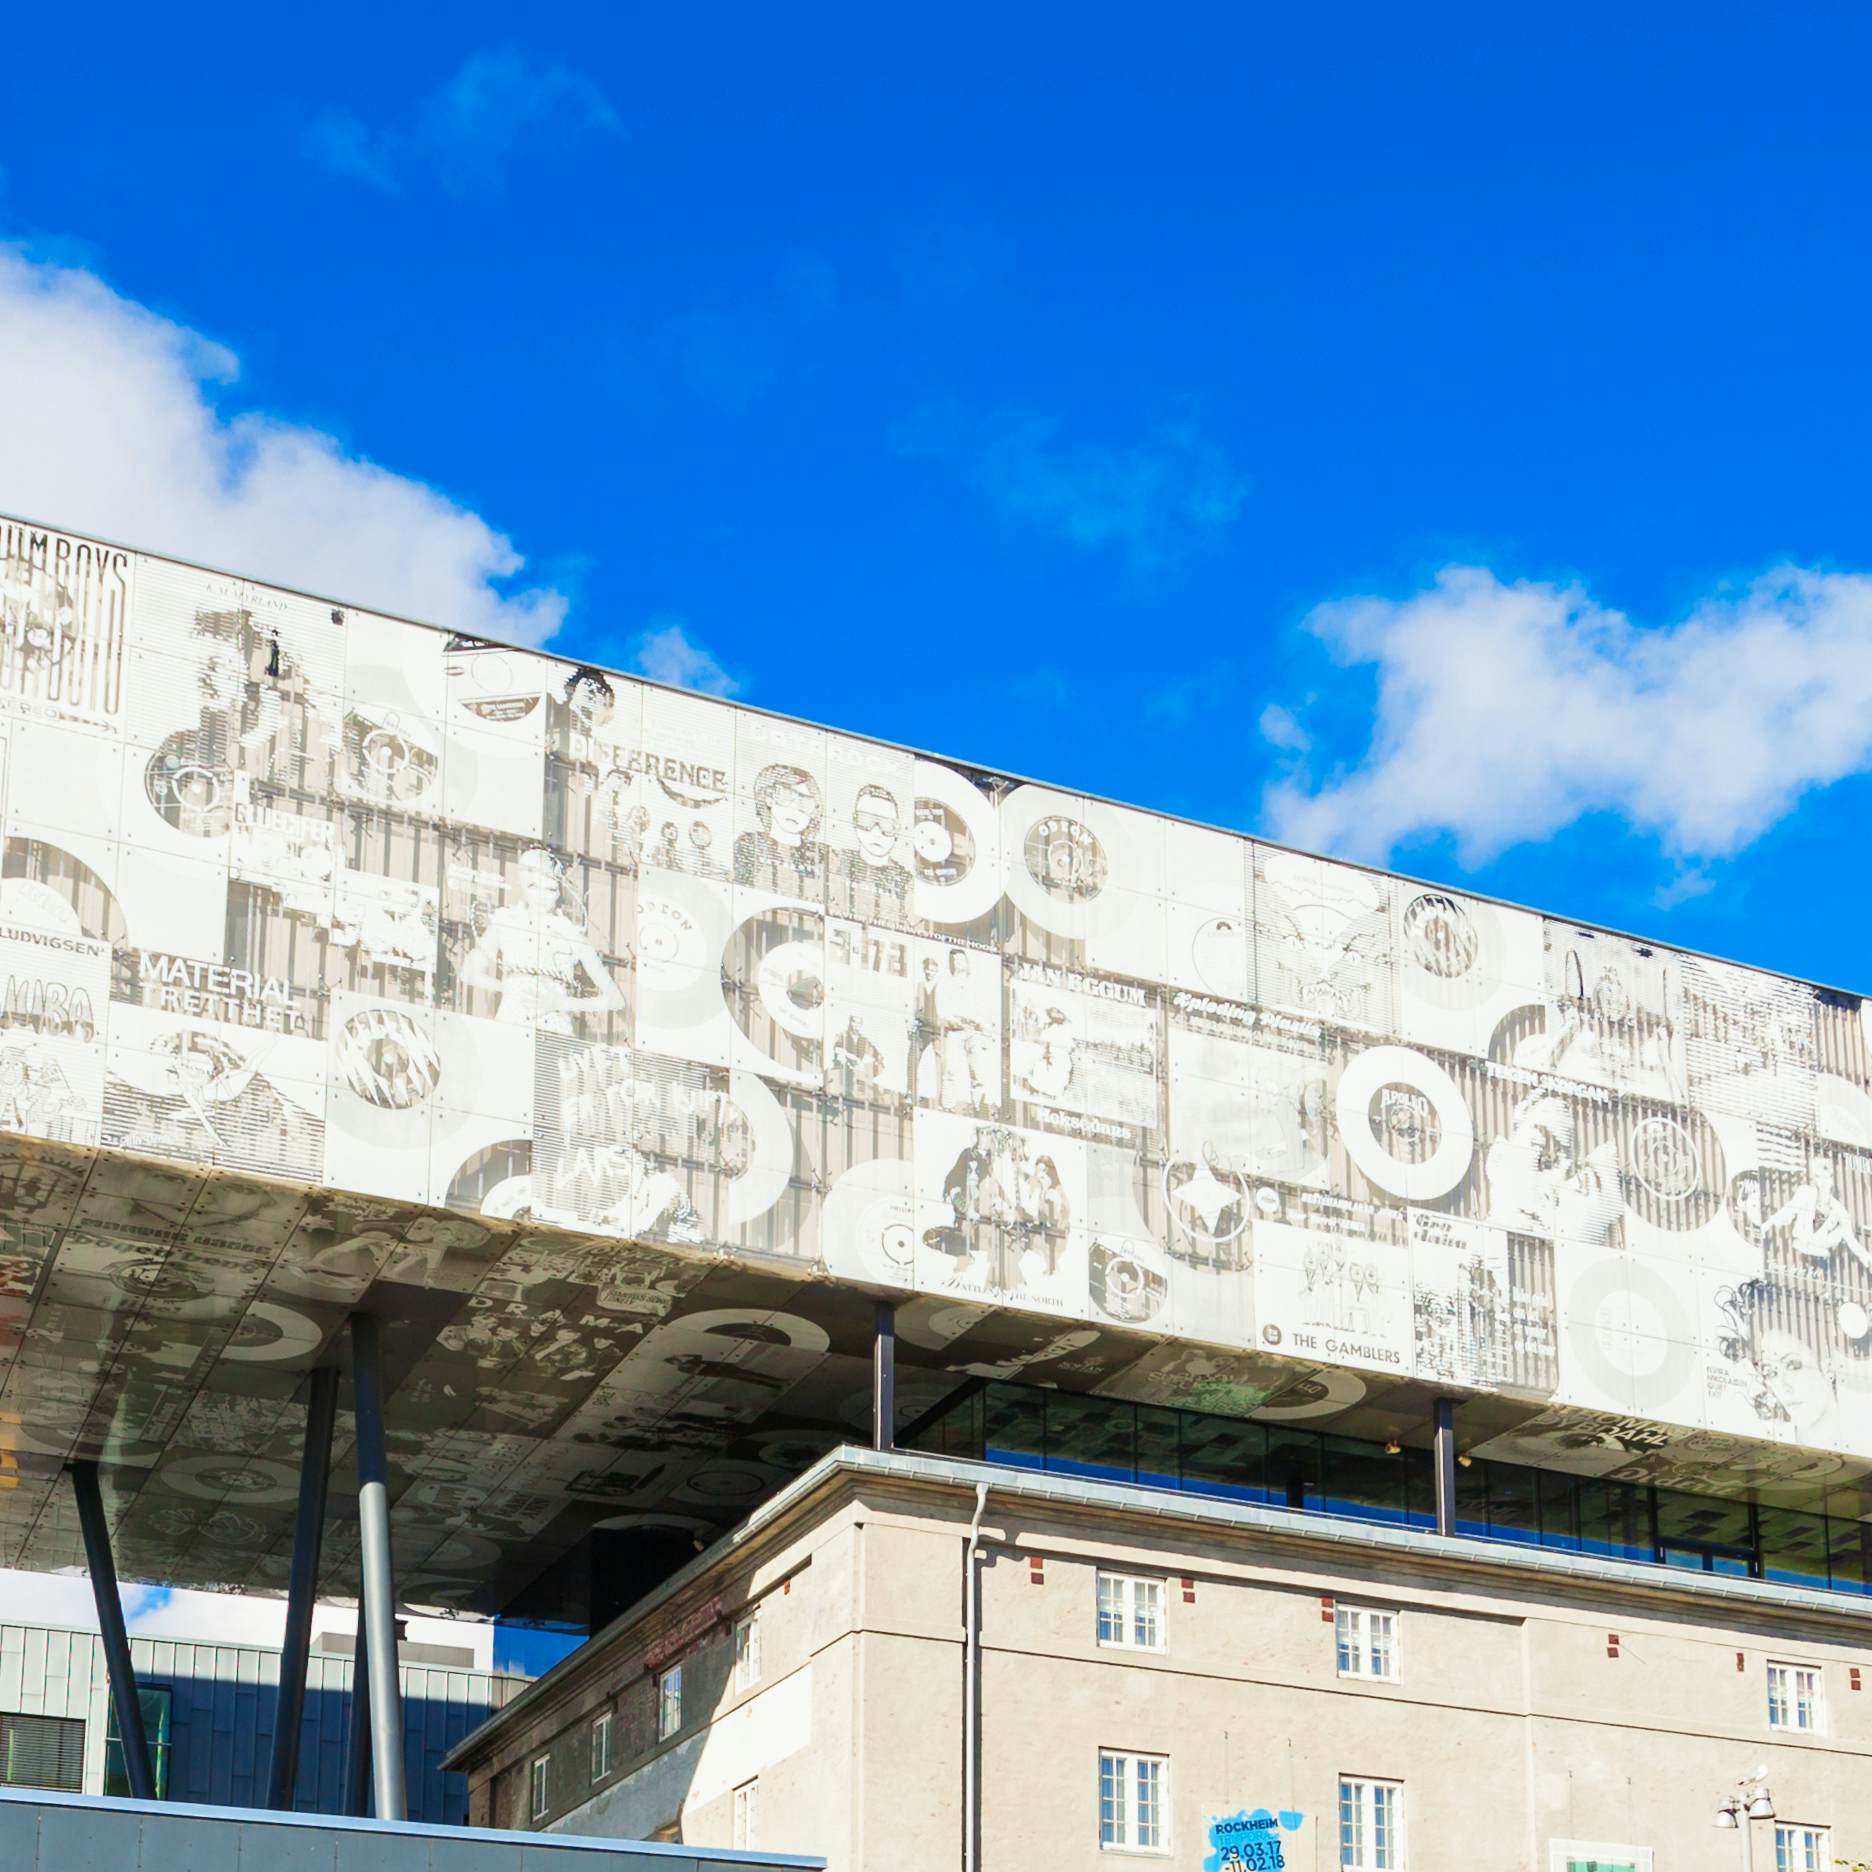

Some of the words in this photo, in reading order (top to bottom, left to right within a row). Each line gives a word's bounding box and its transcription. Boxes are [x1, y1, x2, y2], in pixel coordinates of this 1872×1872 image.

[138, 952, 298, 1007] MATERIAL
[1070, 971, 1148, 1008] EGGUM
[467, 1295, 644, 1335] DRAMA
[1292, 1330, 1318, 1350] THE
[1324, 1336, 1401, 1366] GAMBLERS
[1215, 1817, 1279, 1835] ROCKHEIM
[1220, 1840, 1282, 1861] 29.03.17
